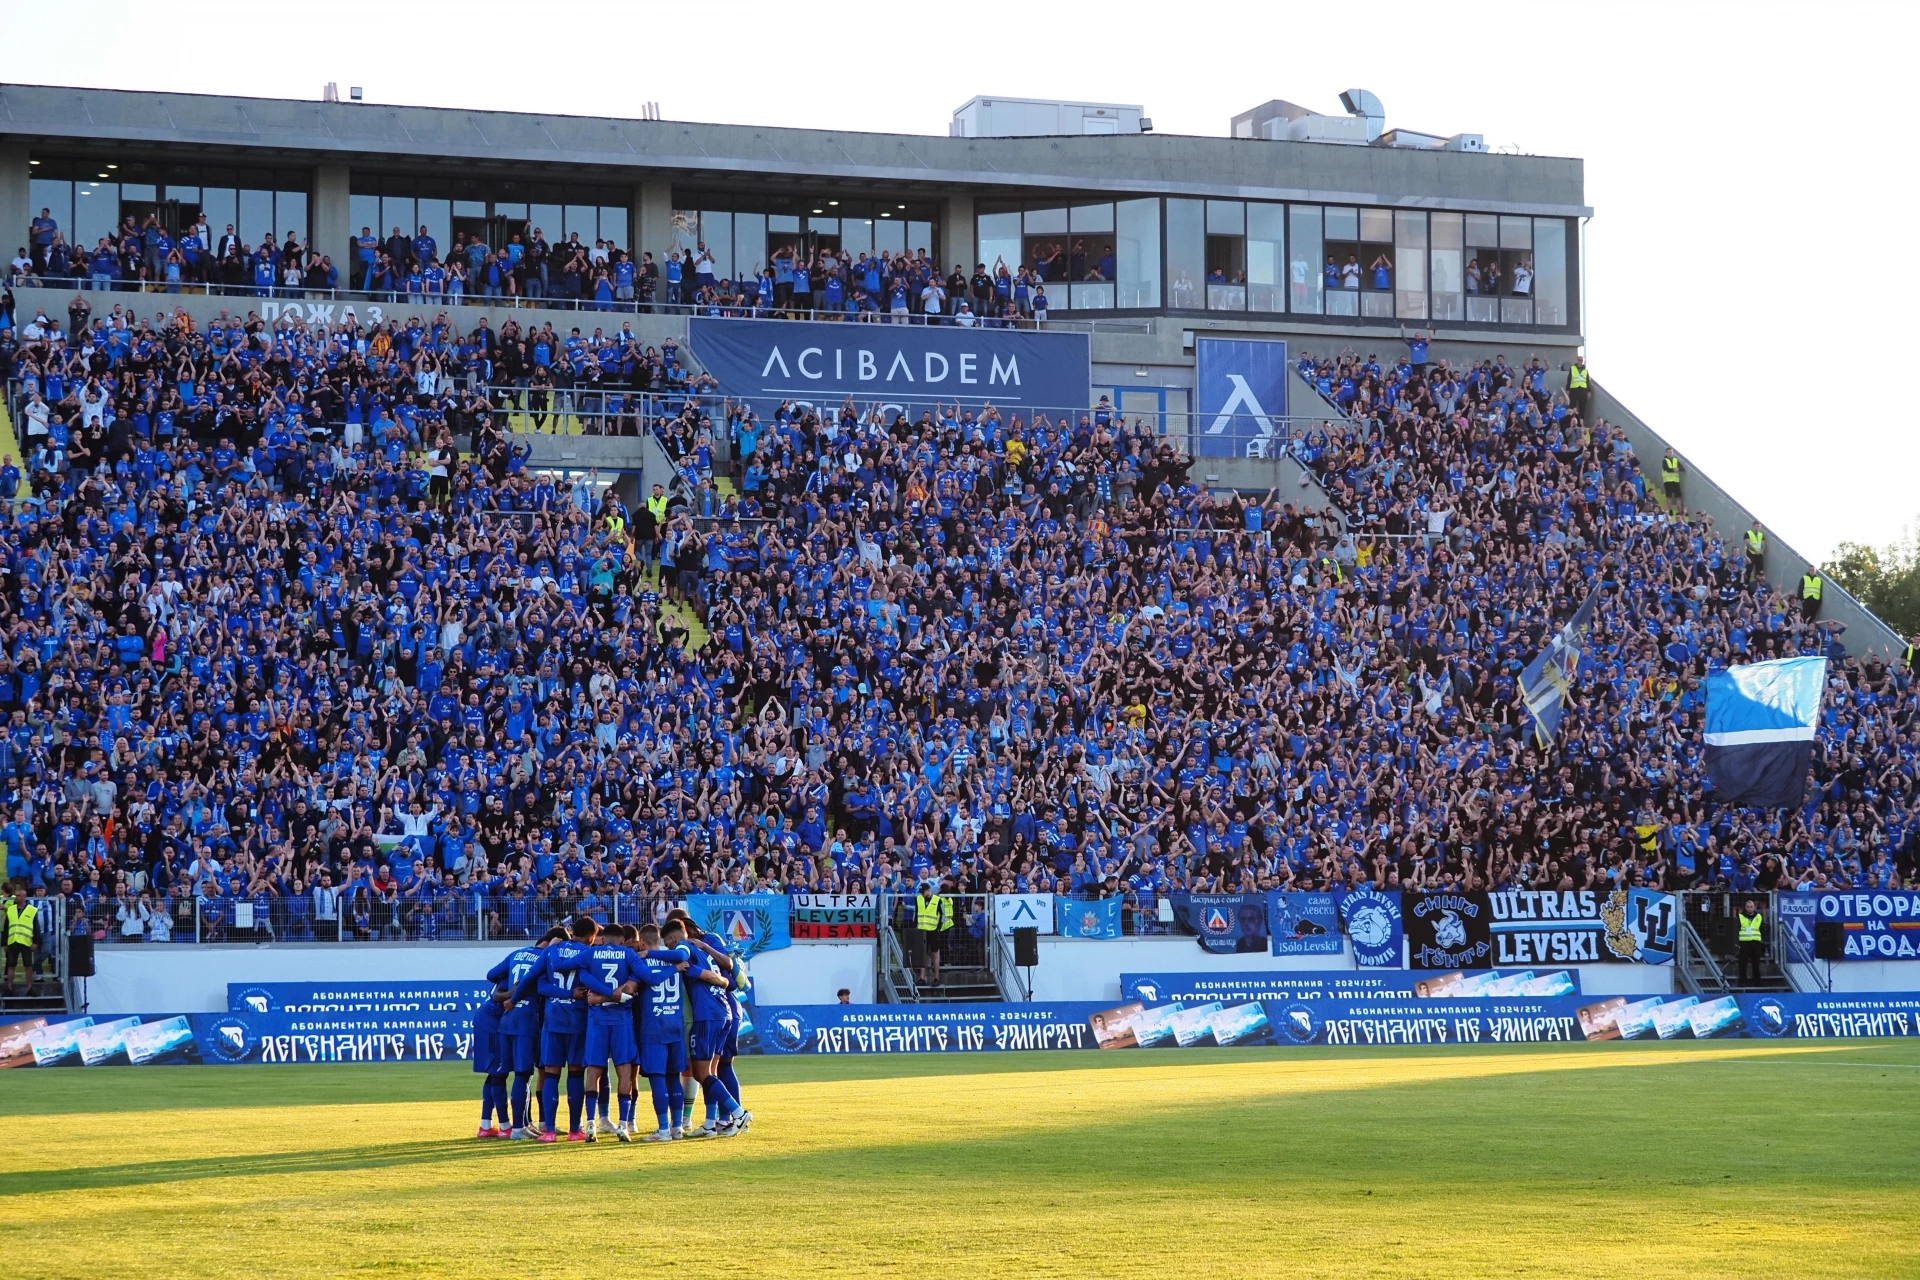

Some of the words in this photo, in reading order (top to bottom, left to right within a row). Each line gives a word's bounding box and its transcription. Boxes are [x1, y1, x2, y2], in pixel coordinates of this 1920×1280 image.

[762, 346, 1020, 385] ACIBADEM
[706, 898, 770, 906] ПАНАГЮРИЩЕ
[798, 895, 871, 907] ULTRA
[1369, 891, 1401, 920] LEVSKI
[1488, 890, 1595, 920] ULTRAS
[1781, 905, 1813, 913] РАЗЛОГ
[797, 910, 871, 922] LEVSKI
[800, 925, 871, 938] HISAR
[1868, 921, 1885, 930] НА
[1304, 941, 1338, 951] Levski!
[1498, 932, 1599, 963] LEVSKI
[593, 950, 625, 959] МАЙКОН
[601, 963, 619, 994] 3
[313, 991, 394, 1000] АБОНАМЕНТНА
[291, 1022, 378, 1030] АБОНАМЕНТНА
[1326, 1019, 1446, 1045] ЛЕГЕНДИТЕ
[1455, 1018, 1479, 1042] НЕ
[1487, 1017, 1573, 1042] УМИРАТ
[1795, 1013, 1908, 1037] ЛЕГЕНДИТЕ
[817, 1026, 948, 1053] ЛЕГЕНДИТЕ
[957, 1025, 983, 1050] НЕ
[992, 1024, 1086, 1050] УМИРАТ
[262, 1034, 405, 1062] ЛЕГЕНДИТЕ
[416, 1034, 444, 1059] НЕ
